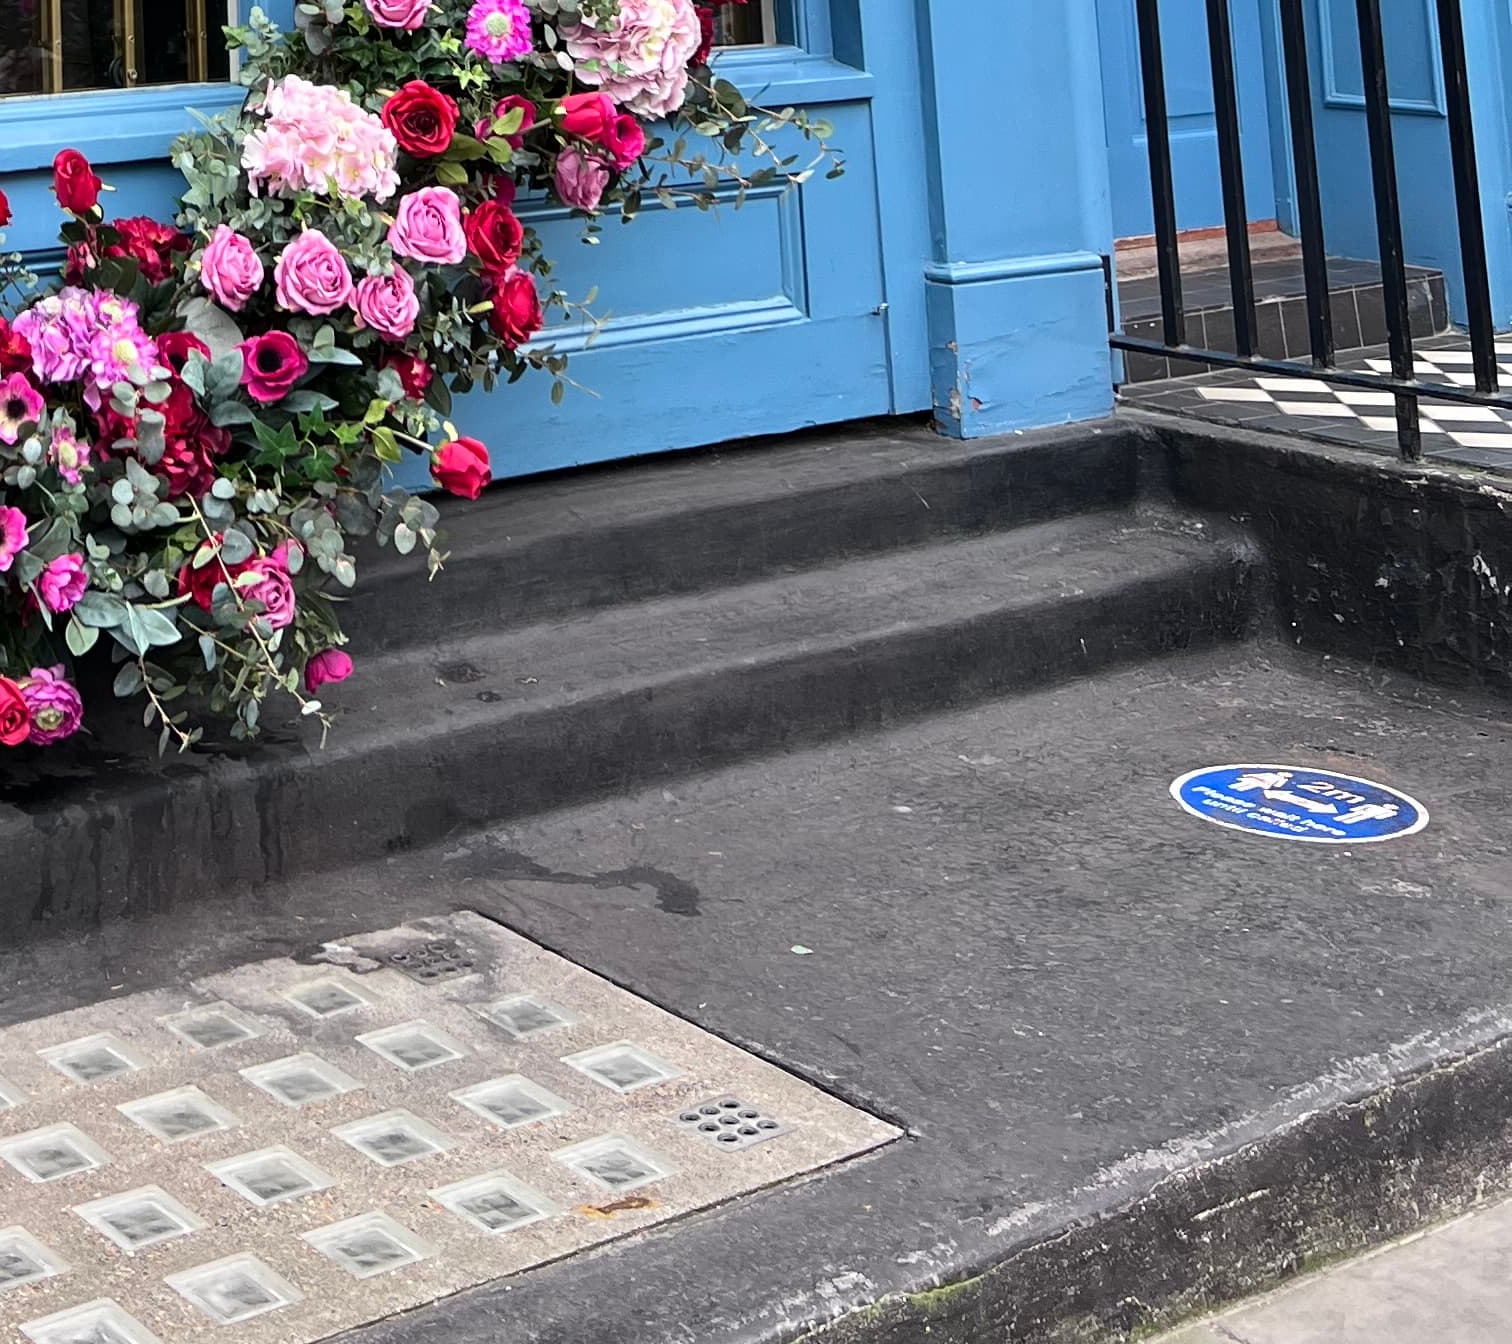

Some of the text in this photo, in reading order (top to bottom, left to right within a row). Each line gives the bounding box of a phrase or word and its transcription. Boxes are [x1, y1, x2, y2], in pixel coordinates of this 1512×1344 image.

[1295, 780, 1366, 805] 2m
[1191, 785, 1347, 837] Please wait here
[1201, 798, 1249, 814] until
